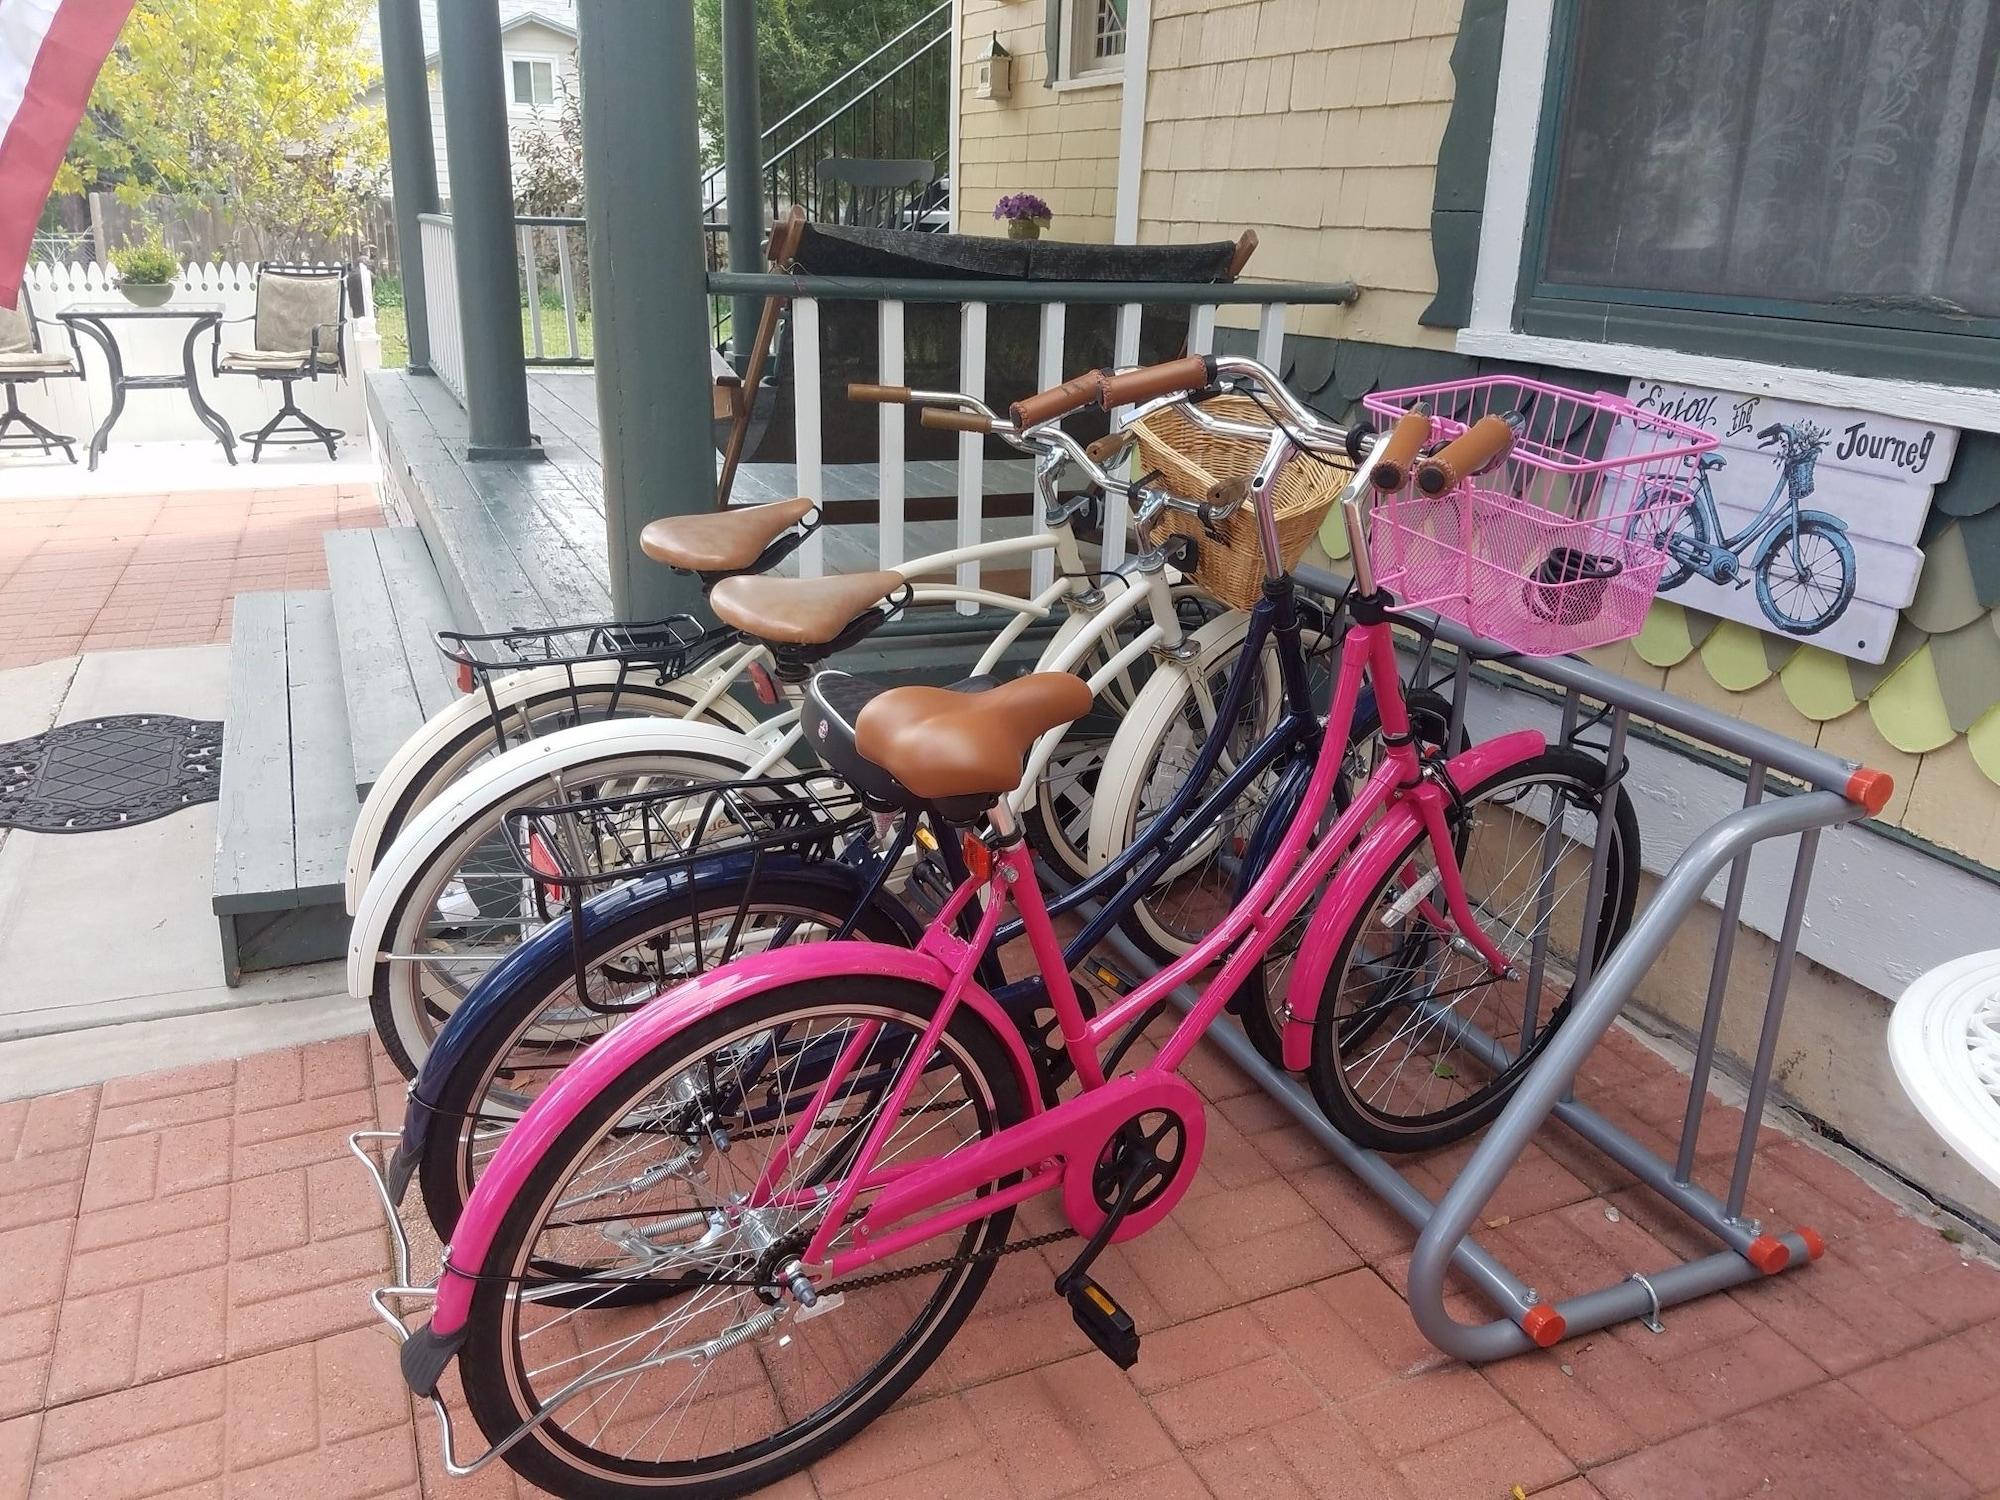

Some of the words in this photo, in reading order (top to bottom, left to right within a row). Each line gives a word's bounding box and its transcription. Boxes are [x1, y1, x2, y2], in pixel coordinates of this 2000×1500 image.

[1633, 385, 1718, 445] Enjoy
[1729, 399, 1757, 434] the
[1836, 421, 1936, 474] Journey
